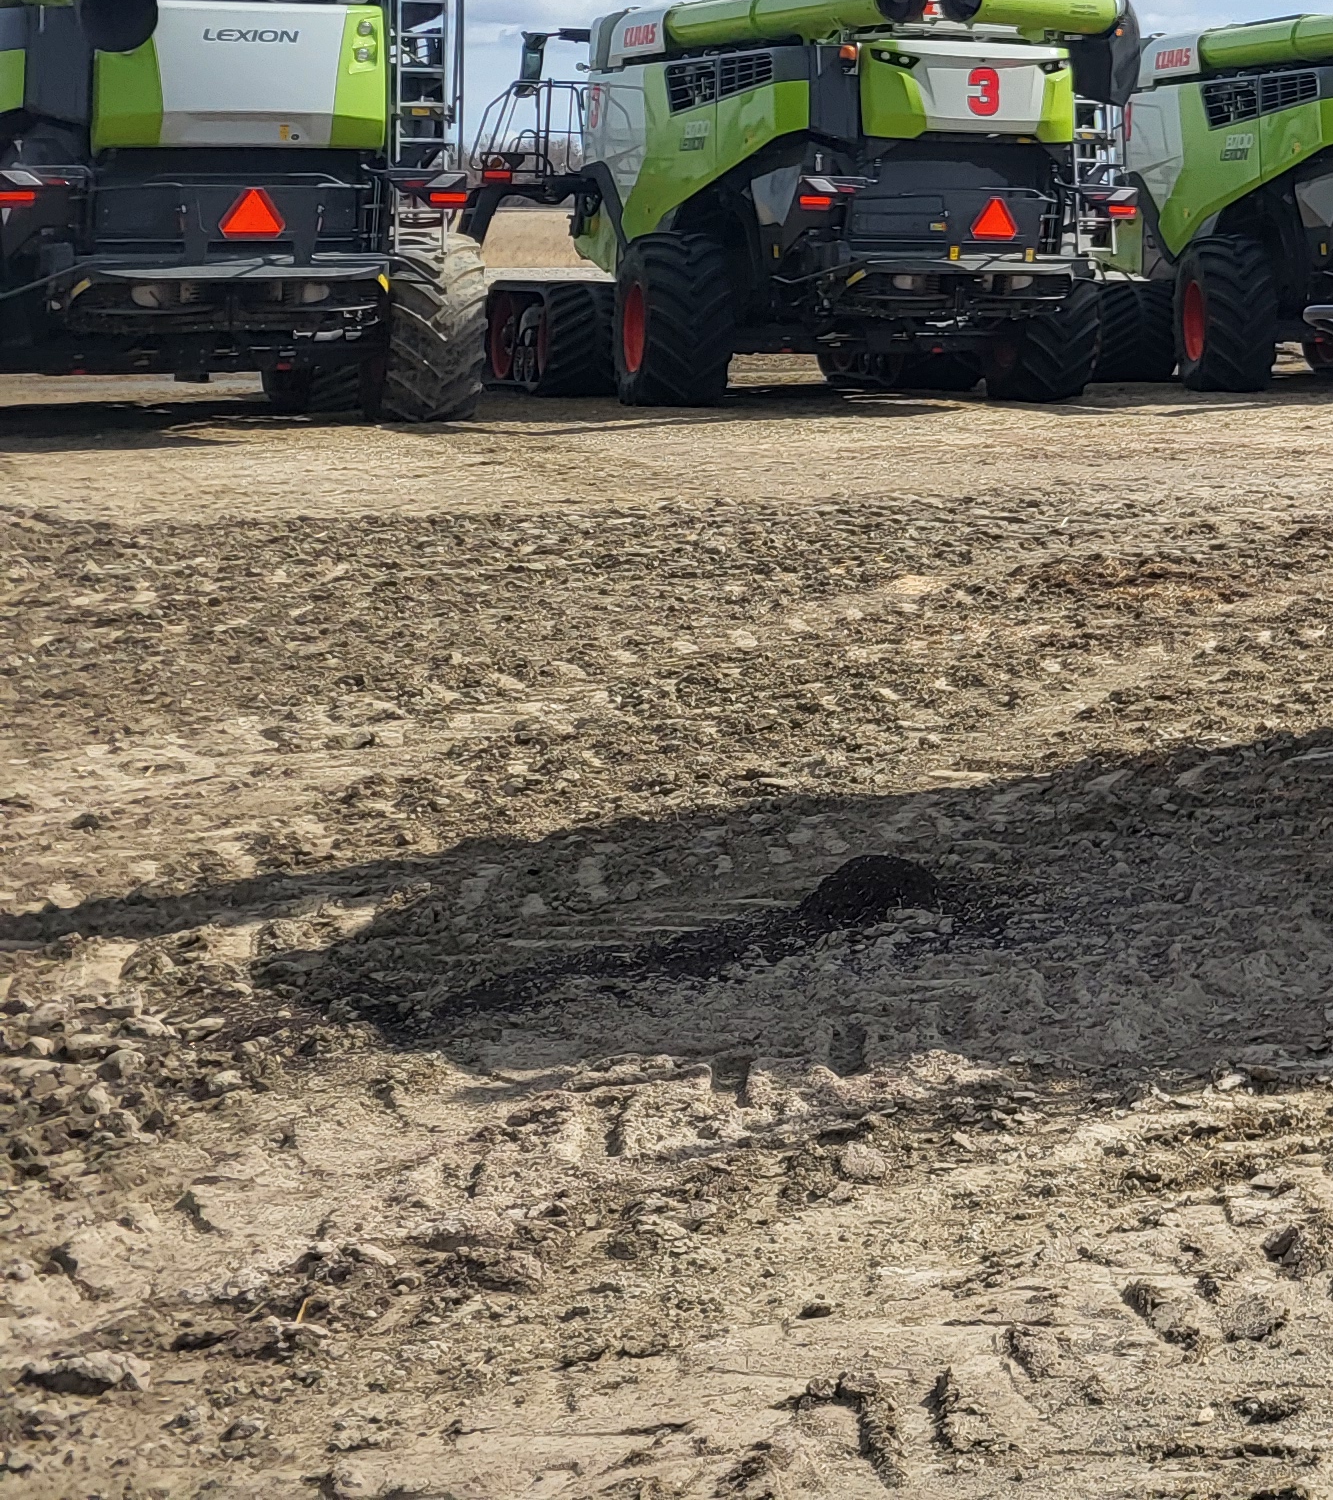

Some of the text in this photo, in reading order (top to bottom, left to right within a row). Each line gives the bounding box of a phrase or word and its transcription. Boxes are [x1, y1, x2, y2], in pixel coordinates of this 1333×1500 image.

[202, 28, 299, 44] LEXION
[623, 22, 658, 49] CLAAS
[1155, 47, 1192, 70] CLAAS
[967, 66, 1000, 117] 3
